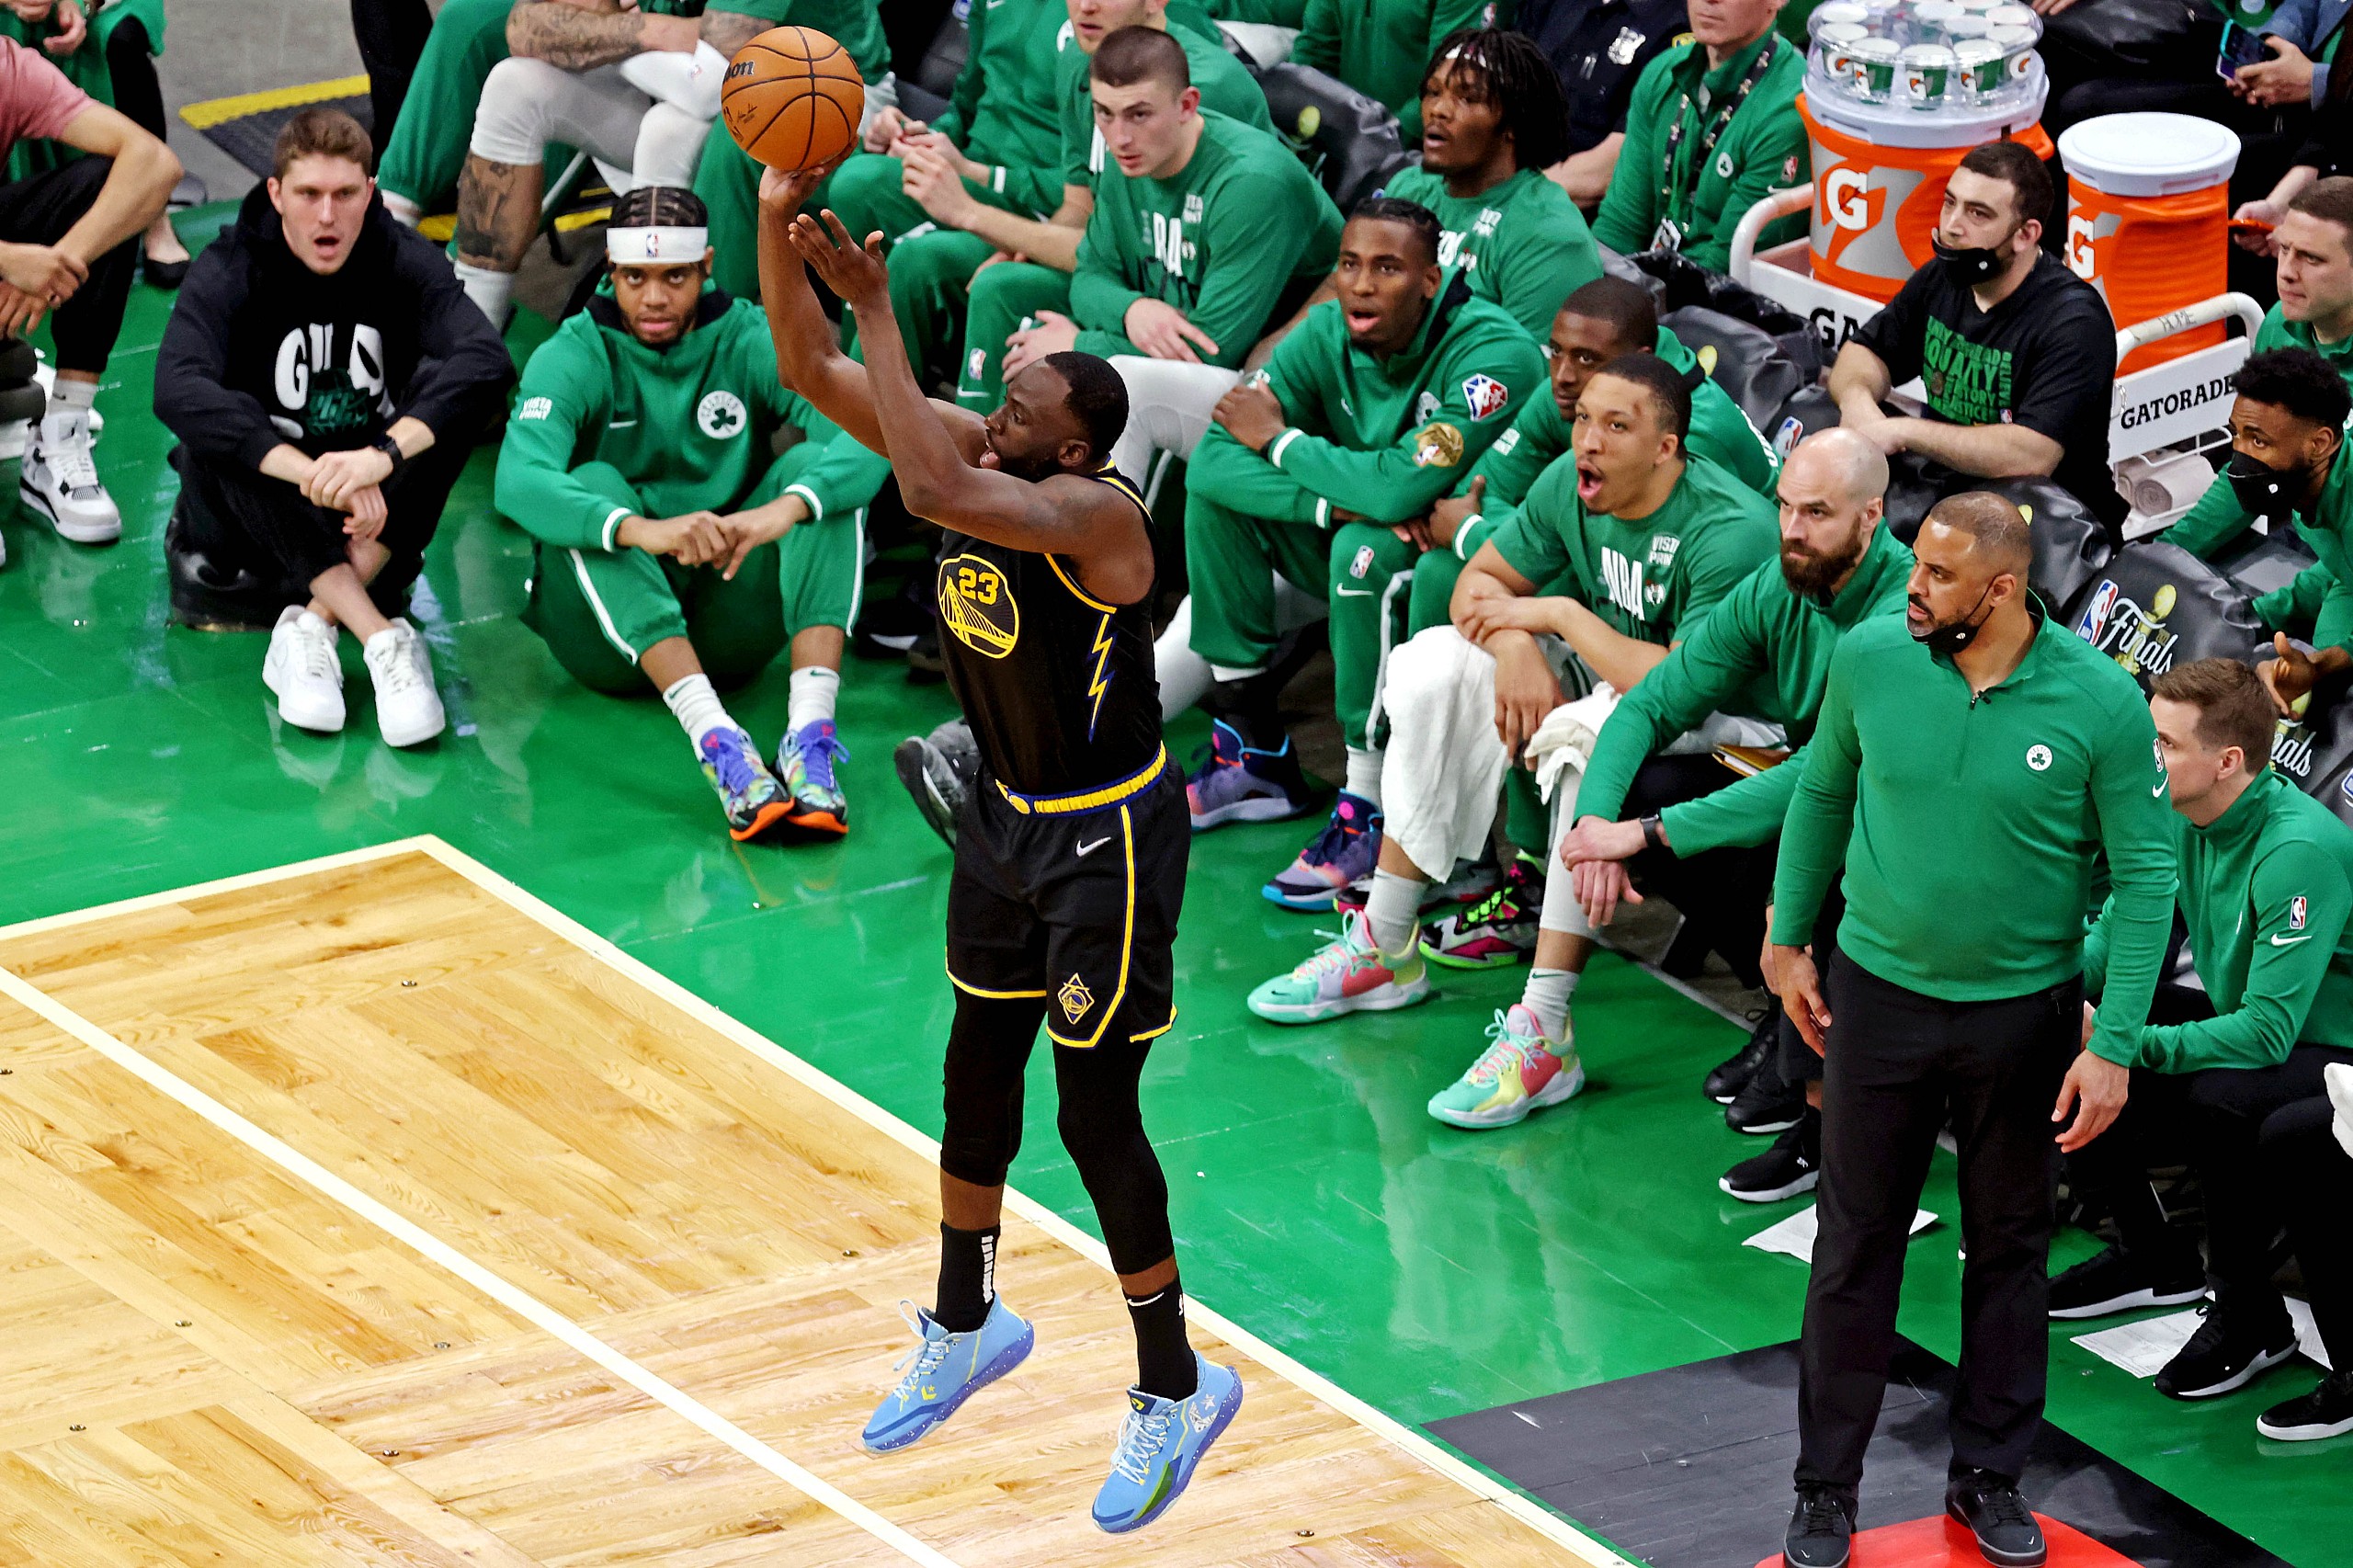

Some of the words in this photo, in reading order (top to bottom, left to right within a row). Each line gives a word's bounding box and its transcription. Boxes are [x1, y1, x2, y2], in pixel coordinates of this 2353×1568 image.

[1826, 168, 1868, 230] G
[2069, 214, 2095, 279] G
[2120, 374, 2239, 430] GATORADE
[959, 566, 999, 606] 23
[1601, 546, 1645, 621] NBA
[2097, 597, 2179, 676] Finals
